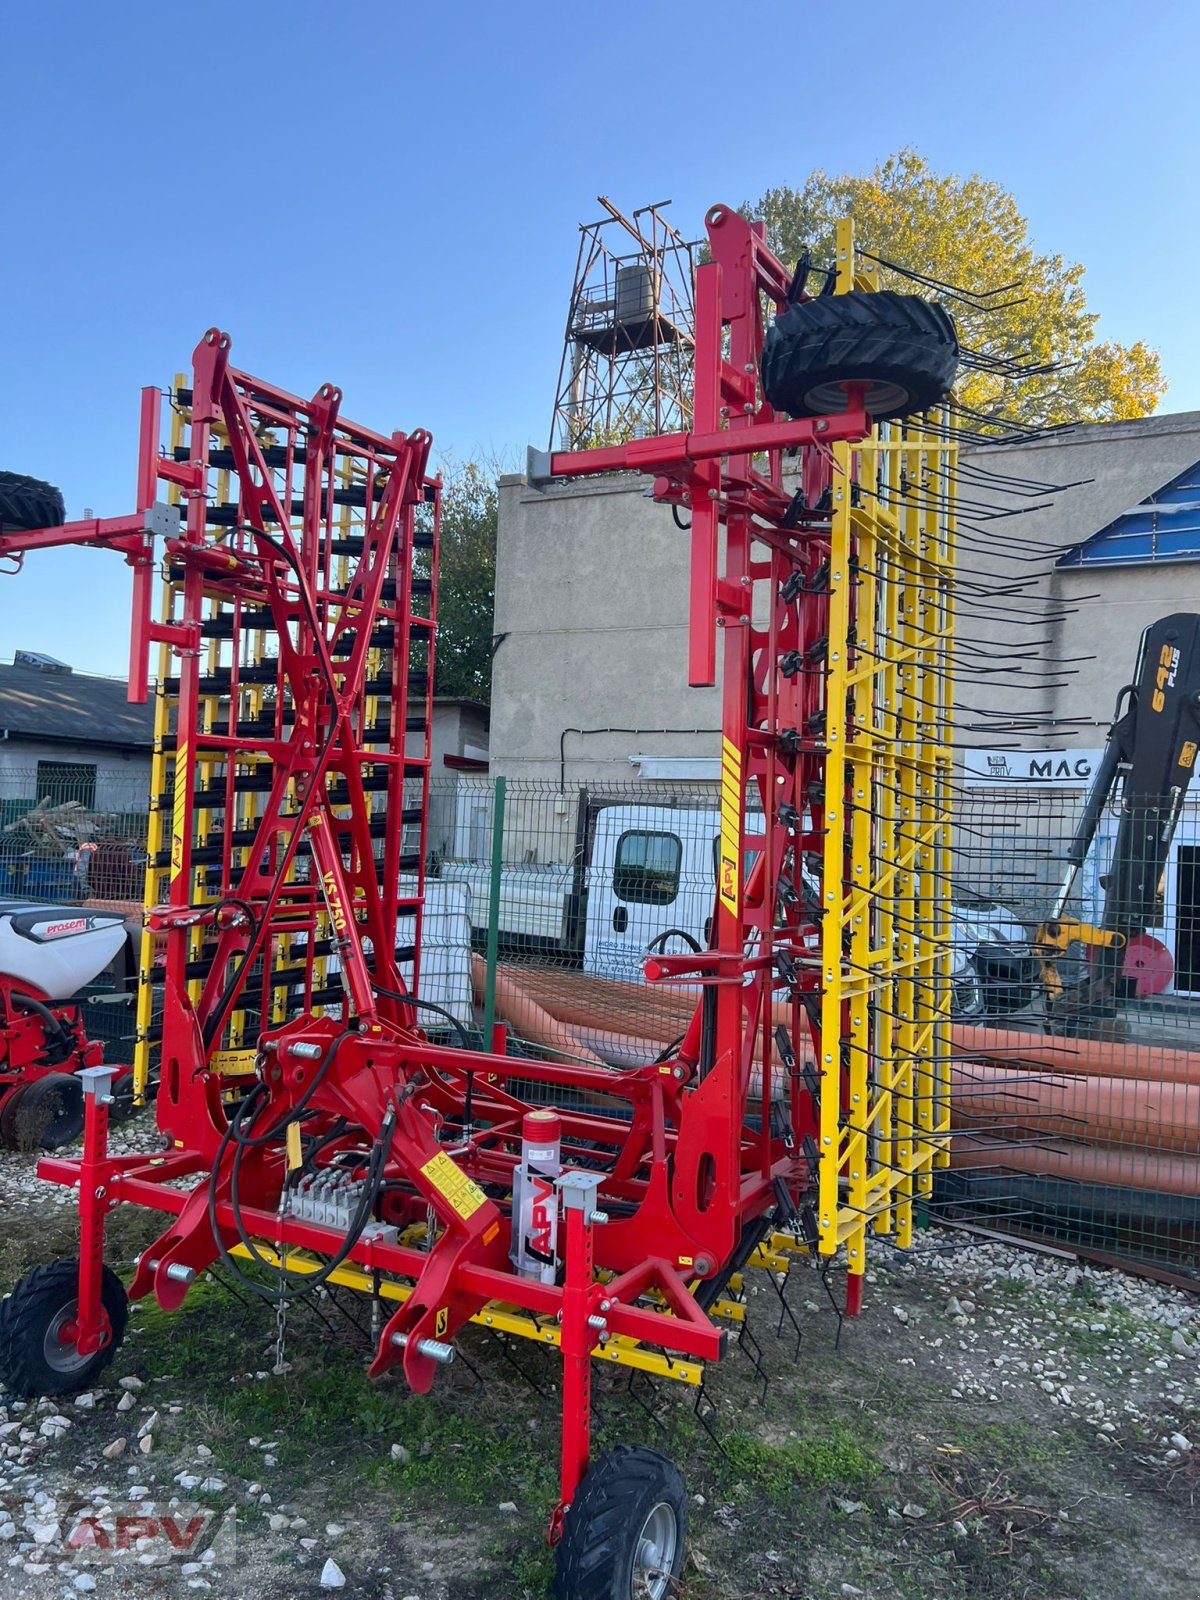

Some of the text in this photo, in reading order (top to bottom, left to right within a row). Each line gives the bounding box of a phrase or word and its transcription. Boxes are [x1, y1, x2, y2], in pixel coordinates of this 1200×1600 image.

[1151, 644, 1174, 713] 642
[1167, 647, 1181, 688] PLUS
[323, 870, 347, 930] VS 750
[723, 859, 735, 899] APV
[46, 918, 85, 934] prosem
[529, 1175, 554, 1257] APV
